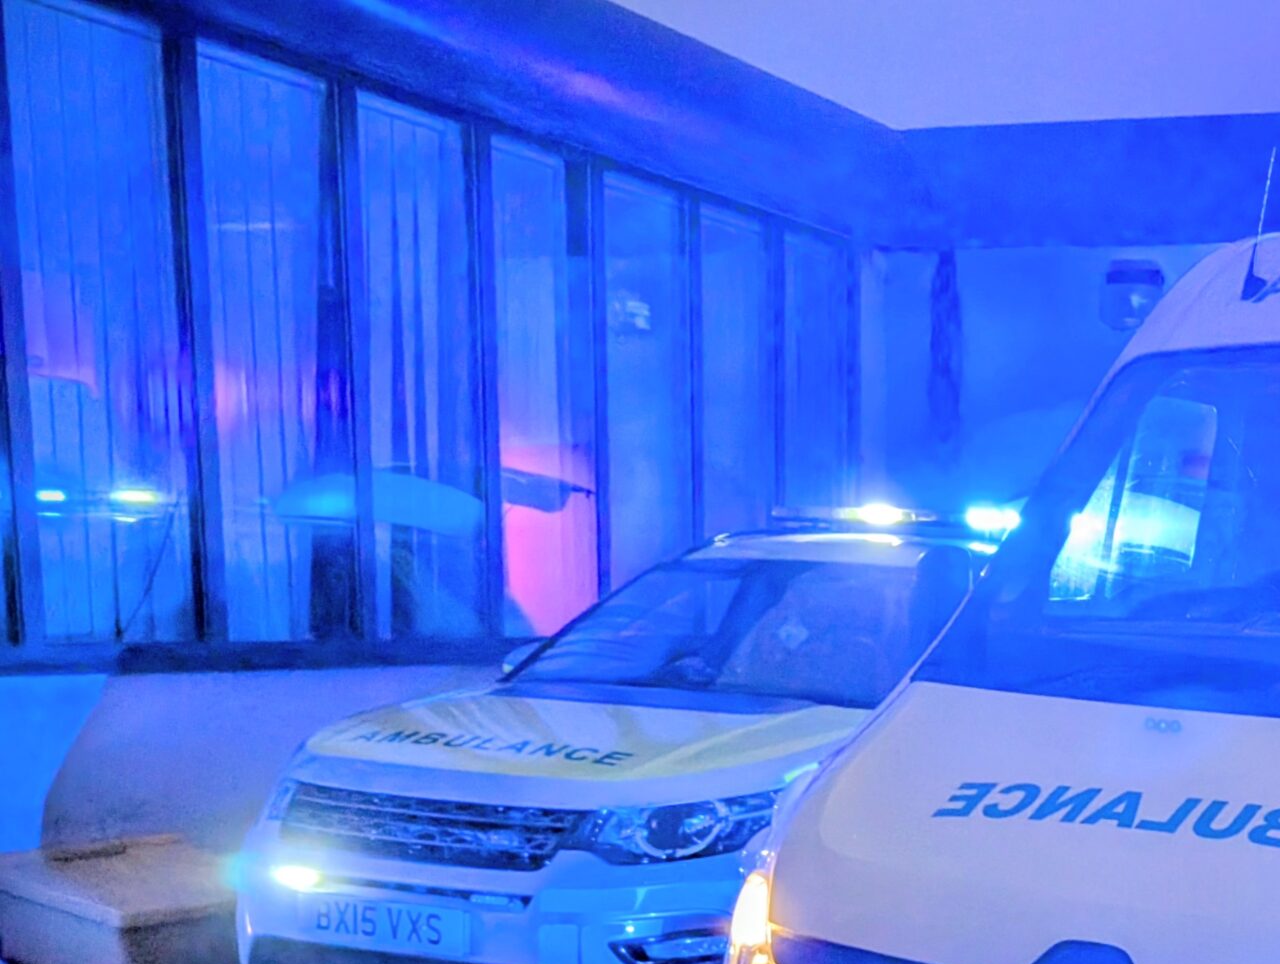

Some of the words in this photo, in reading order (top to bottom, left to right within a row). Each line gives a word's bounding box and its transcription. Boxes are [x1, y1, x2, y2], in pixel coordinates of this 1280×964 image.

[354, 730, 634, 766] AMBULANCE
[316, 901, 377, 937] BX15
[386, 907, 442, 945] VXS
